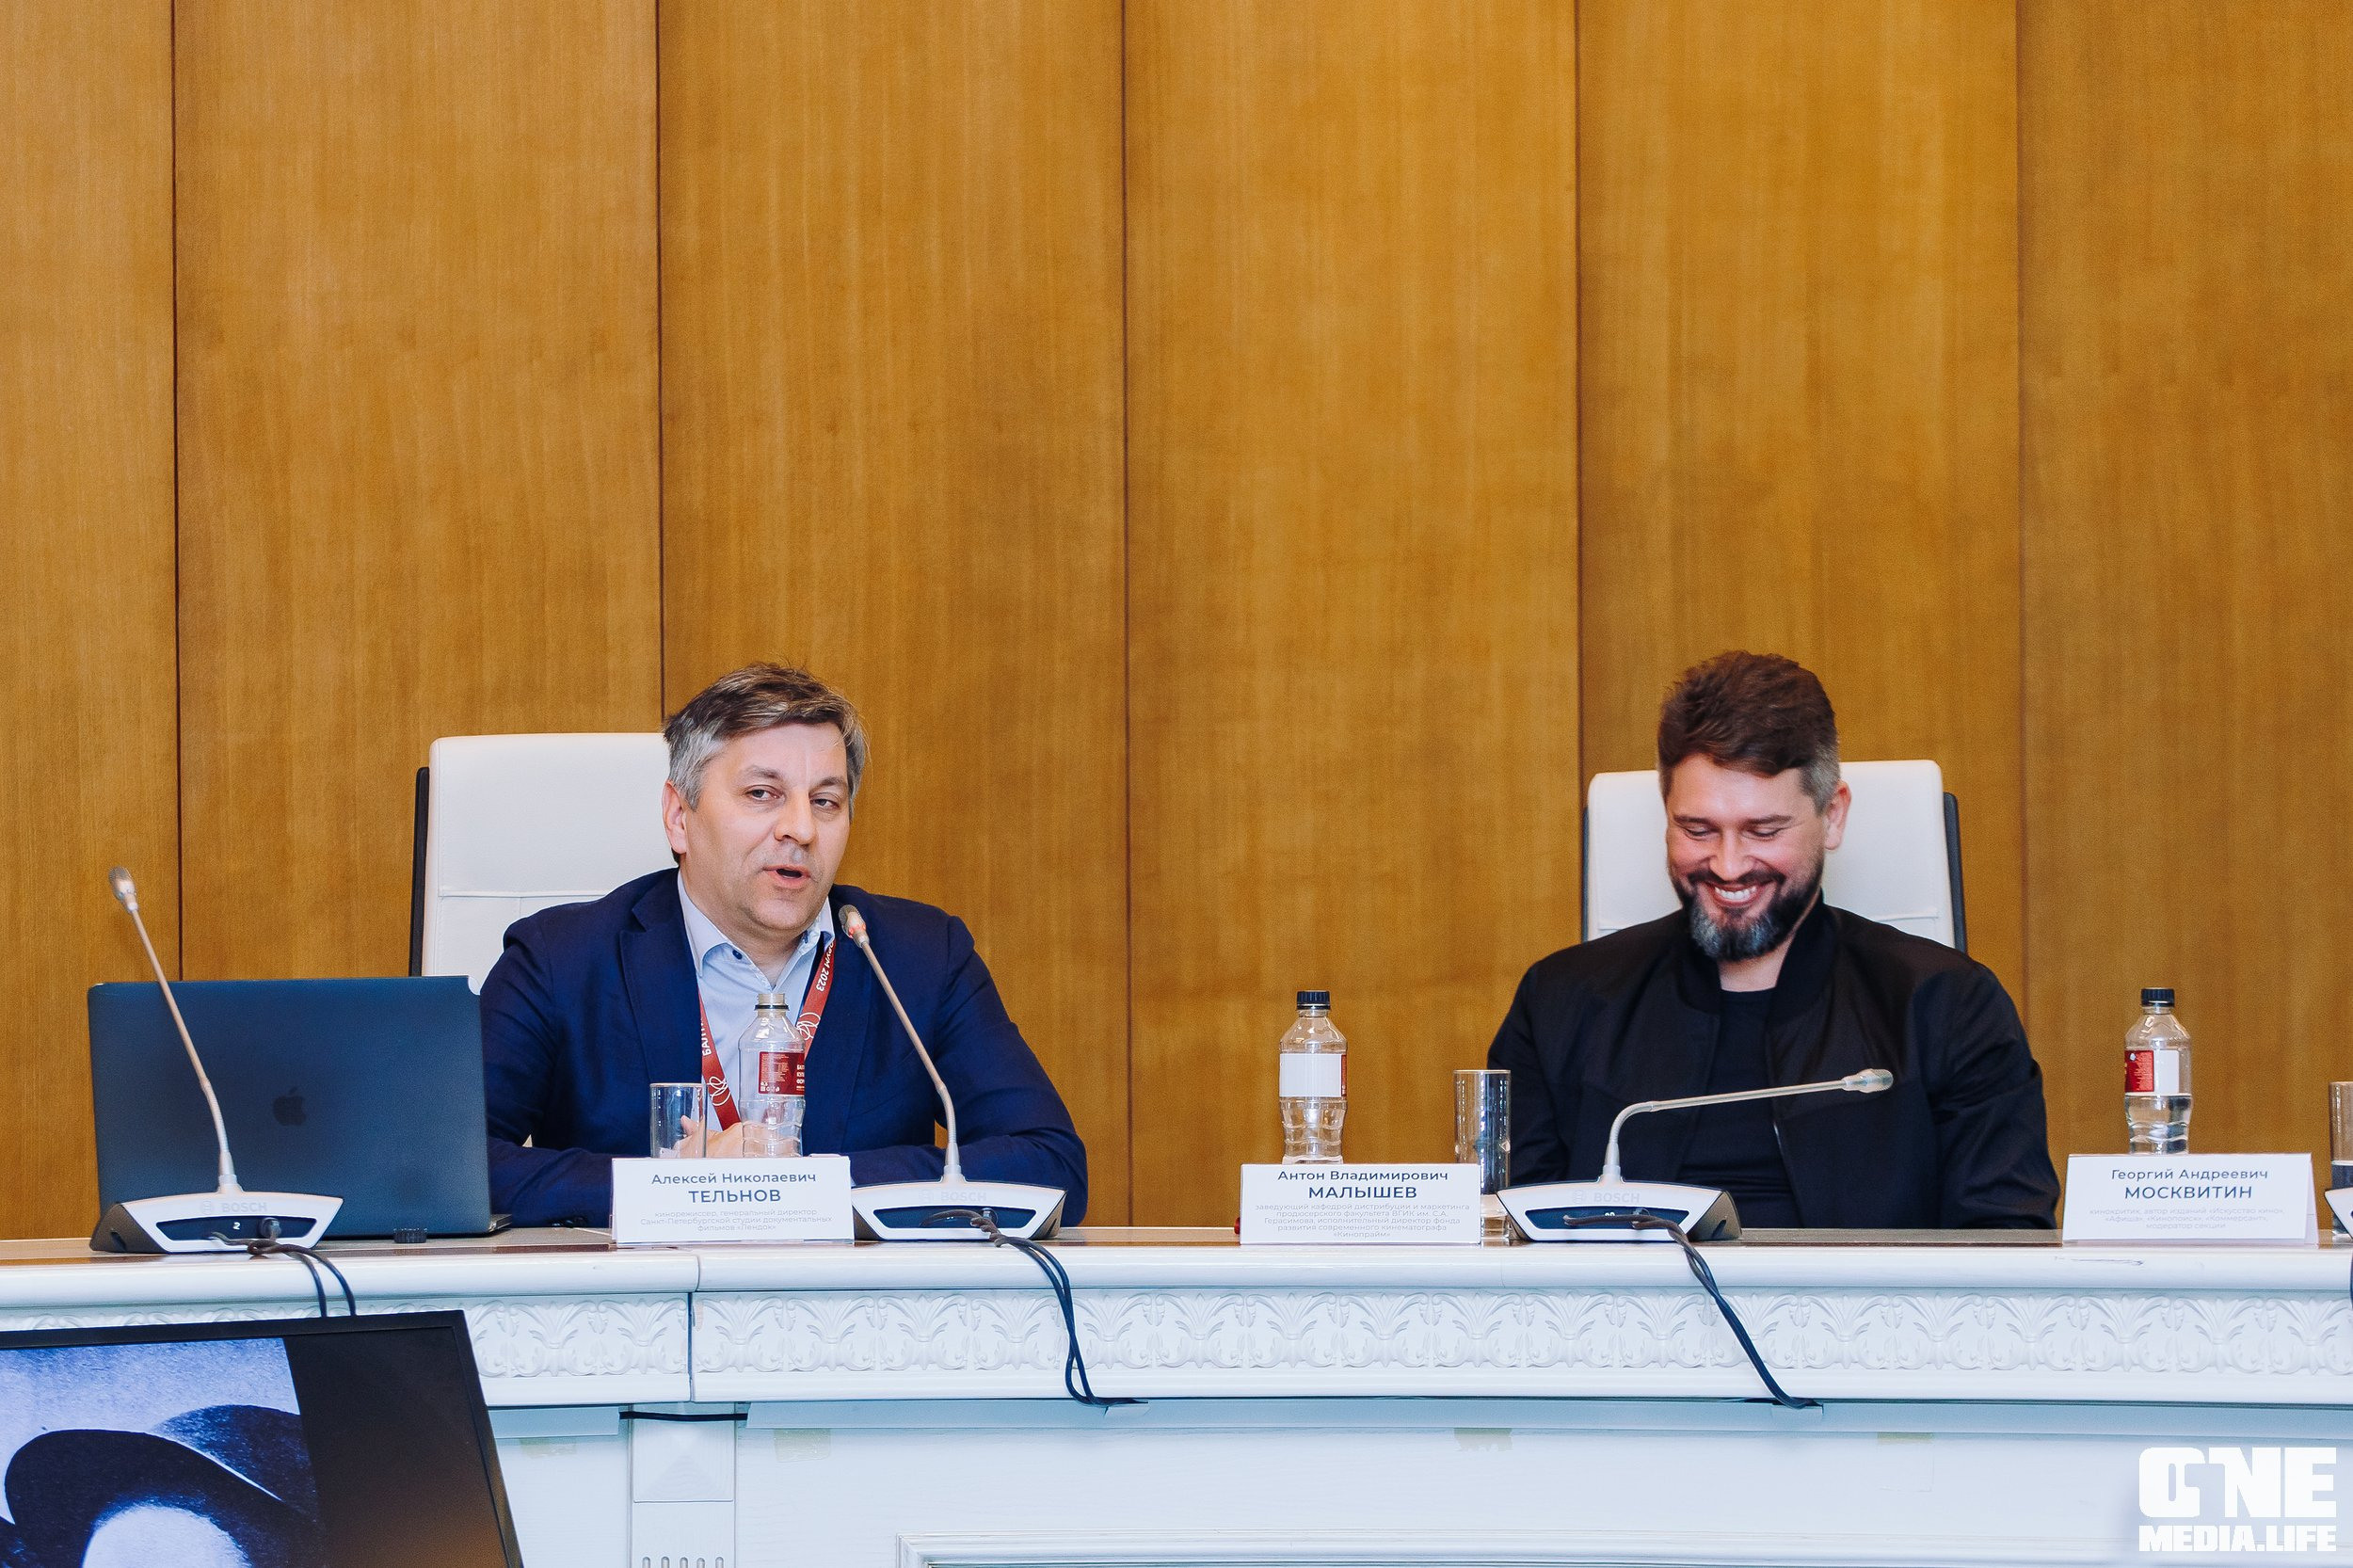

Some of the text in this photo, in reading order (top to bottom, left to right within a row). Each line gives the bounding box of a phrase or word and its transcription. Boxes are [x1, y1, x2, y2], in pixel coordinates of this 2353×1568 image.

[816, 968, 829, 991] 2023
[652, 1172, 816, 1184] Алексей Николаевич
[1278, 1171, 1448, 1182] Антон Владимирович
[2112, 1169, 2267, 1181] Георгий Андреевич
[689, 1190, 780, 1203] ТЕЛЬНОВ
[941, 1192, 986, 1202] BOSCH
[1309, 1187, 1417, 1198] МАЛЫШЕВ
[1593, 1192, 1640, 1203] BOSCH
[2125, 1186, 2252, 1199] МОСКВИТИН
[222, 1202, 267, 1212] BOSCH
[232, 1222, 240, 1230] 2
[640, 1217, 729, 1225] Санкт-Петербургской
